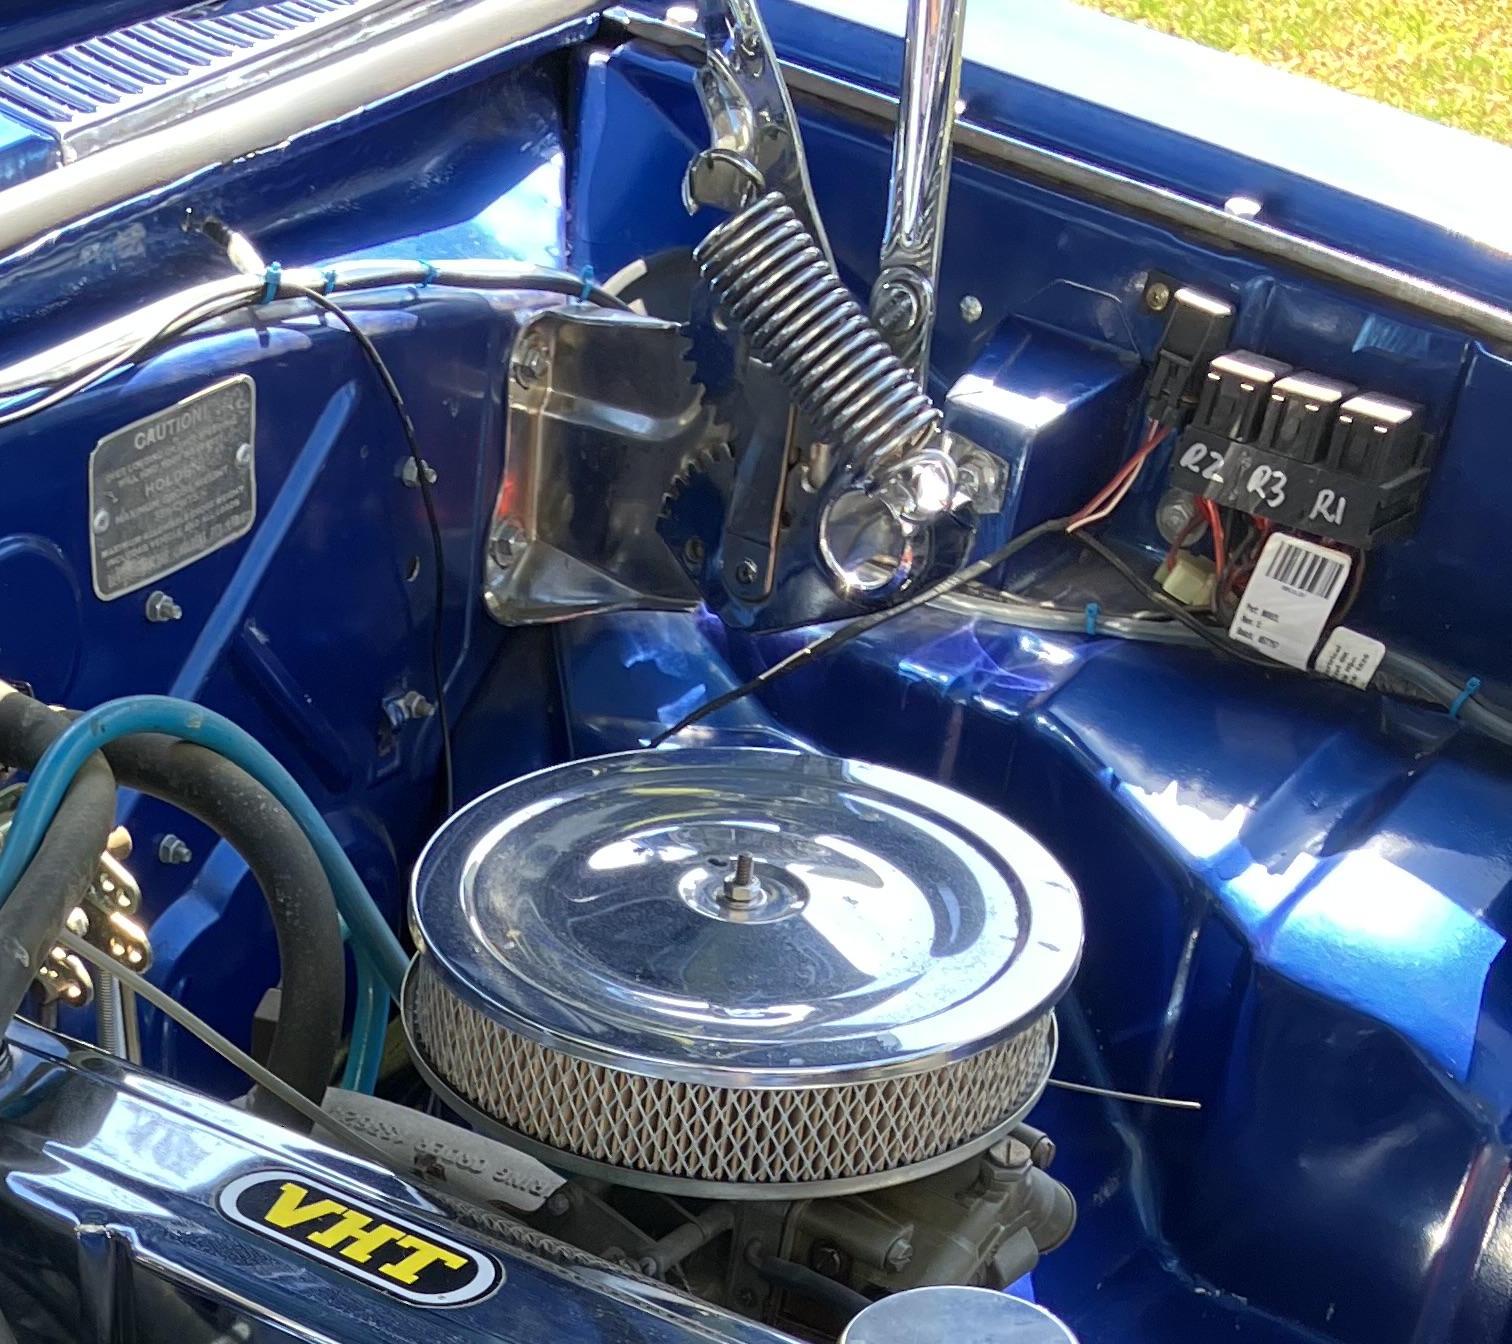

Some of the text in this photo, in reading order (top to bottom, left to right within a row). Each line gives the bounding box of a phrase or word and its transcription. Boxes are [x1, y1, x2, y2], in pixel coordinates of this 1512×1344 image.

[1179, 443, 1347, 525] R2 R3 R1
[264, 1182, 469, 1285] VHT
